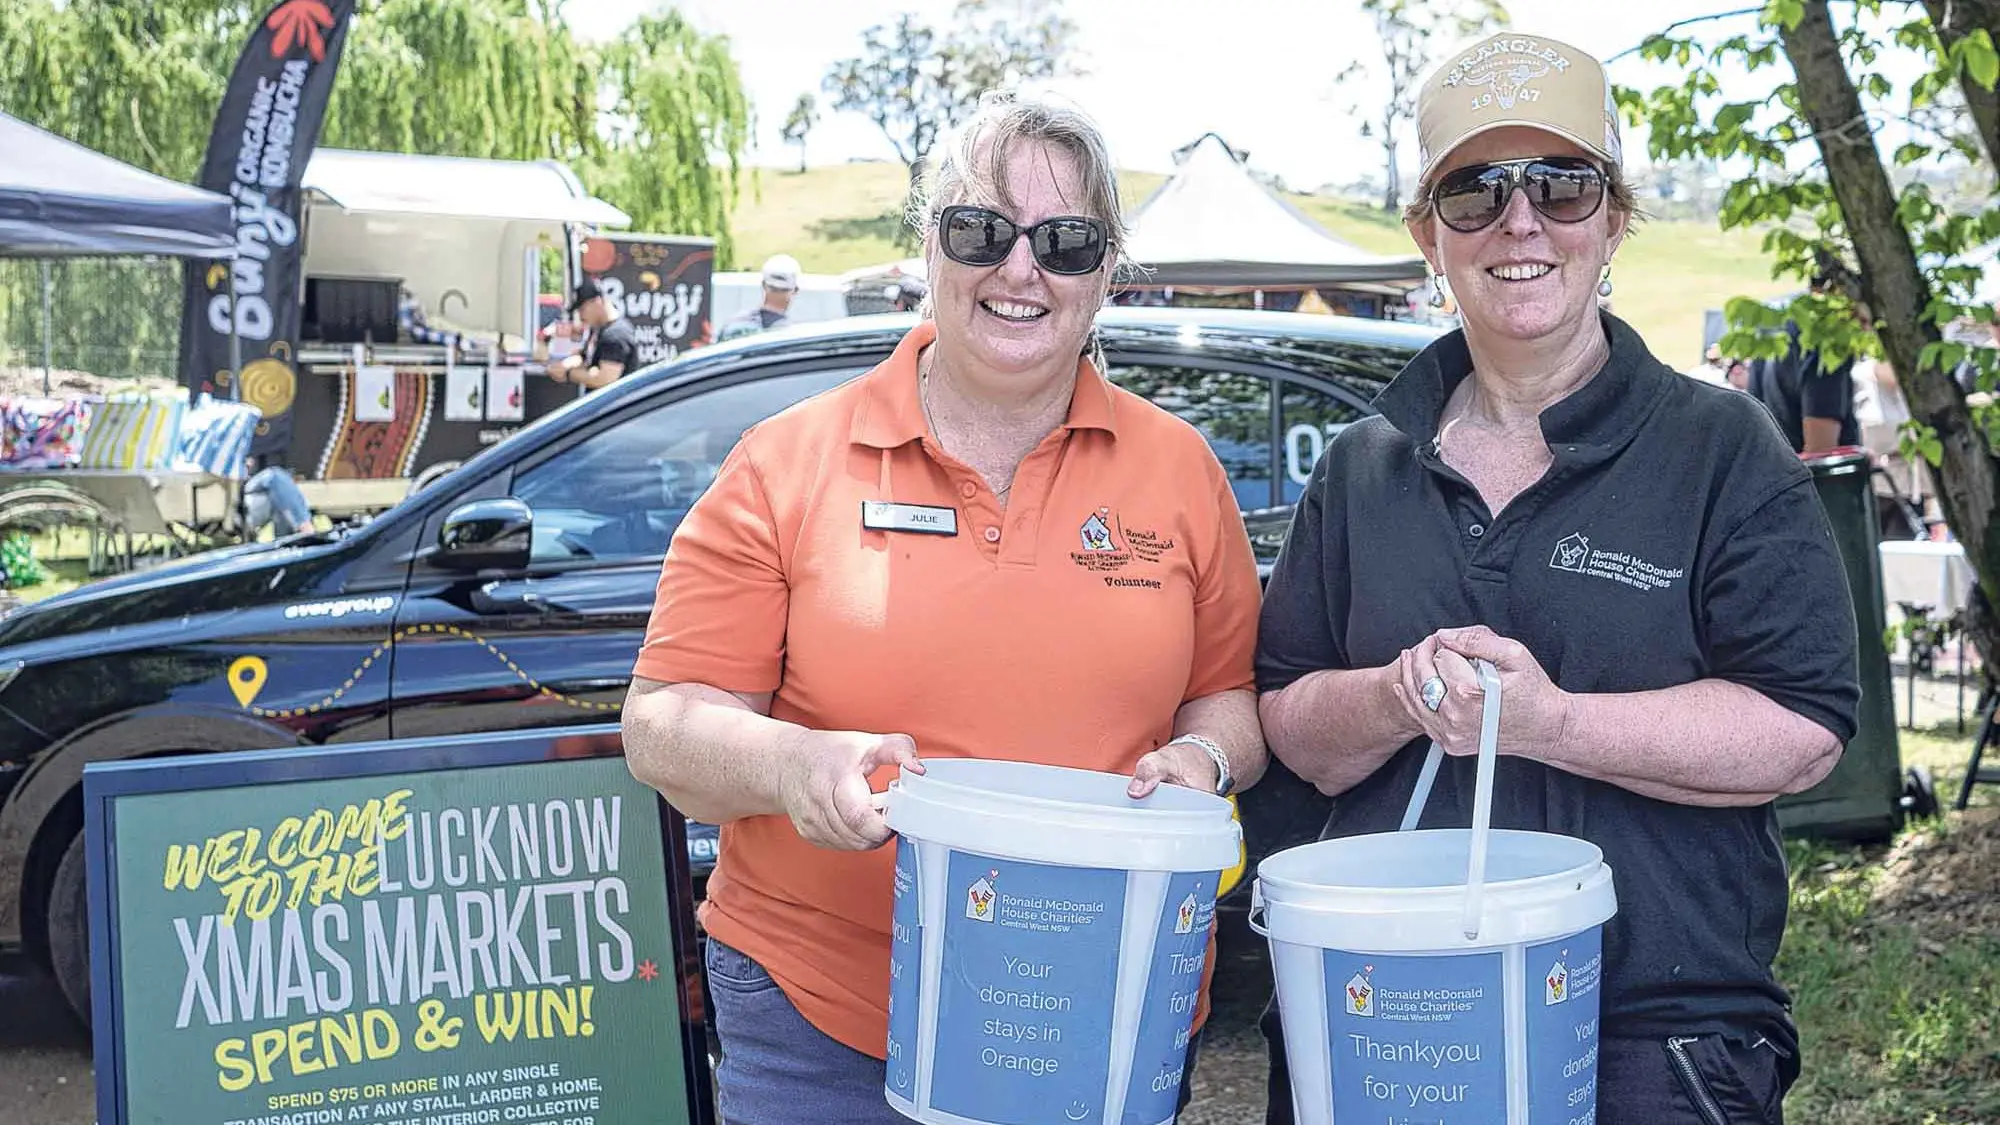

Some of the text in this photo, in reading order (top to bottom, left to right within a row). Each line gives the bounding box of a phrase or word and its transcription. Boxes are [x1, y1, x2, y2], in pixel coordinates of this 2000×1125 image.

[1441, 40, 1571, 88] WRANGLER
[236, 76, 277, 184] ORGANIC
[259, 60, 309, 187] KOMBUCHA
[911, 514, 939, 523] JULIE
[1125, 529, 1157, 540] Ronald
[1128, 538, 1174, 549] McDonald
[1589, 558, 1672, 588] House Charities
[1592, 550, 1683, 578] Ronald McDonald
[1104, 577, 1161, 589] Volunteer
[163, 789, 414, 892] WELCOME
[378, 796, 622, 894] LUCKNOW
[219, 846, 383, 928] TO THE
[1001, 906, 1091, 924] House Charities
[1002, 894, 1104, 912] Ronald McDonald
[1000, 919, 1072, 933] Central West NSW
[173, 877, 636, 1029] XMAS MARKETS
[1003, 956, 1054, 978] Your
[980, 985, 1071, 1011] donation
[1169, 991, 1188, 1014] for
[1380, 988, 1483, 1000] Ronald McDonald
[1380, 1000, 1472, 1012] House Charities
[1381, 1012, 1452, 1021] Central West NSW
[214, 985, 596, 1092] SPEND & WIN!
[984, 1018, 1061, 1044] stays in
[981, 1047, 1058, 1077] Orange
[1349, 1034, 1481, 1068] Thankyou
[268, 1063, 560, 1110] SPEND $75 OR MORE IN ANY SINGLE
[348, 1105, 369, 1120] AT
[374, 1100, 408, 1117] ANY
[412, 1094, 466, 1112] STALL,
[470, 1085, 532, 1106] LARDER
[537, 1083, 549, 1097] &
[551, 1077, 602, 1096] HOME,
[1364, 1075, 1469, 1108] for your
[503, 1096, 600, 1120] COLLECTIVE
